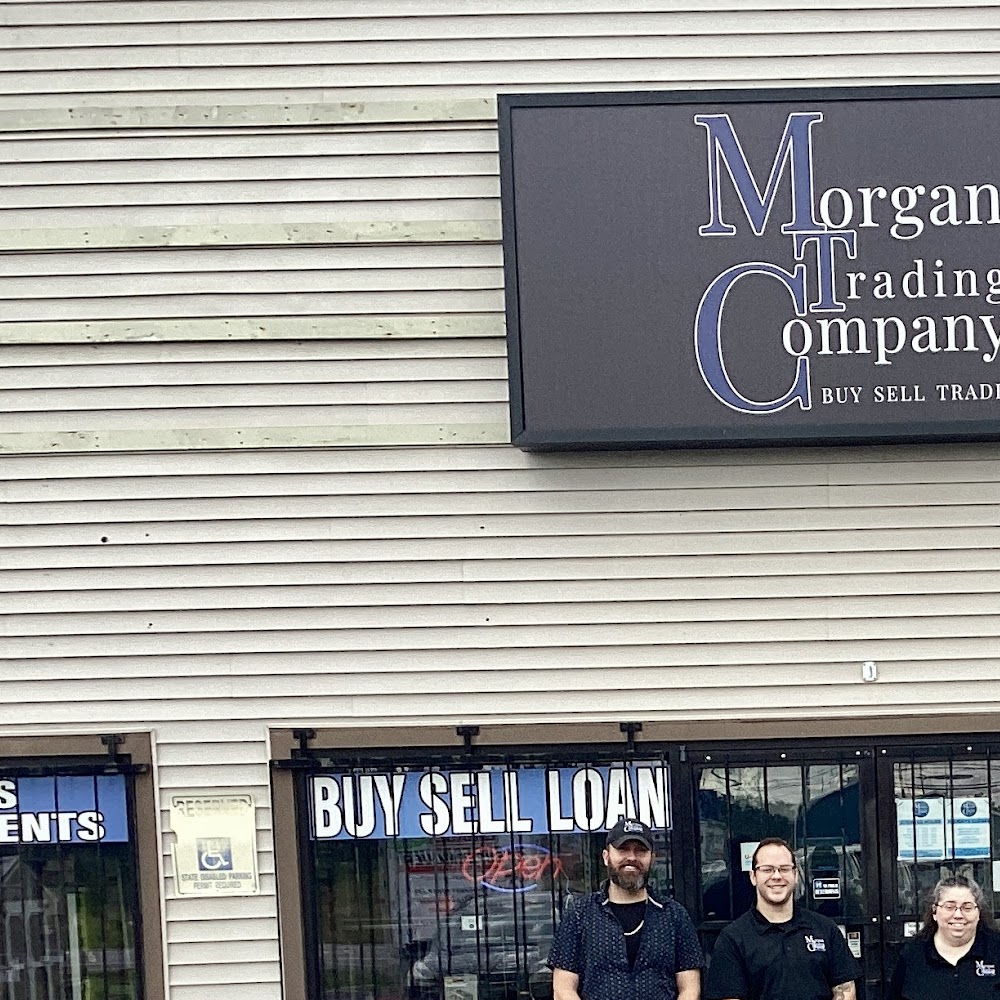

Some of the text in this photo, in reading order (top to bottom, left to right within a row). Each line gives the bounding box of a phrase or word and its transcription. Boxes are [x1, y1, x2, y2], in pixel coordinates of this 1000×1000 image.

[821, 386, 864, 405] BUY
[873, 385, 926, 403] SELL
[312, 766, 671, 839] BUY SELL LOAN
